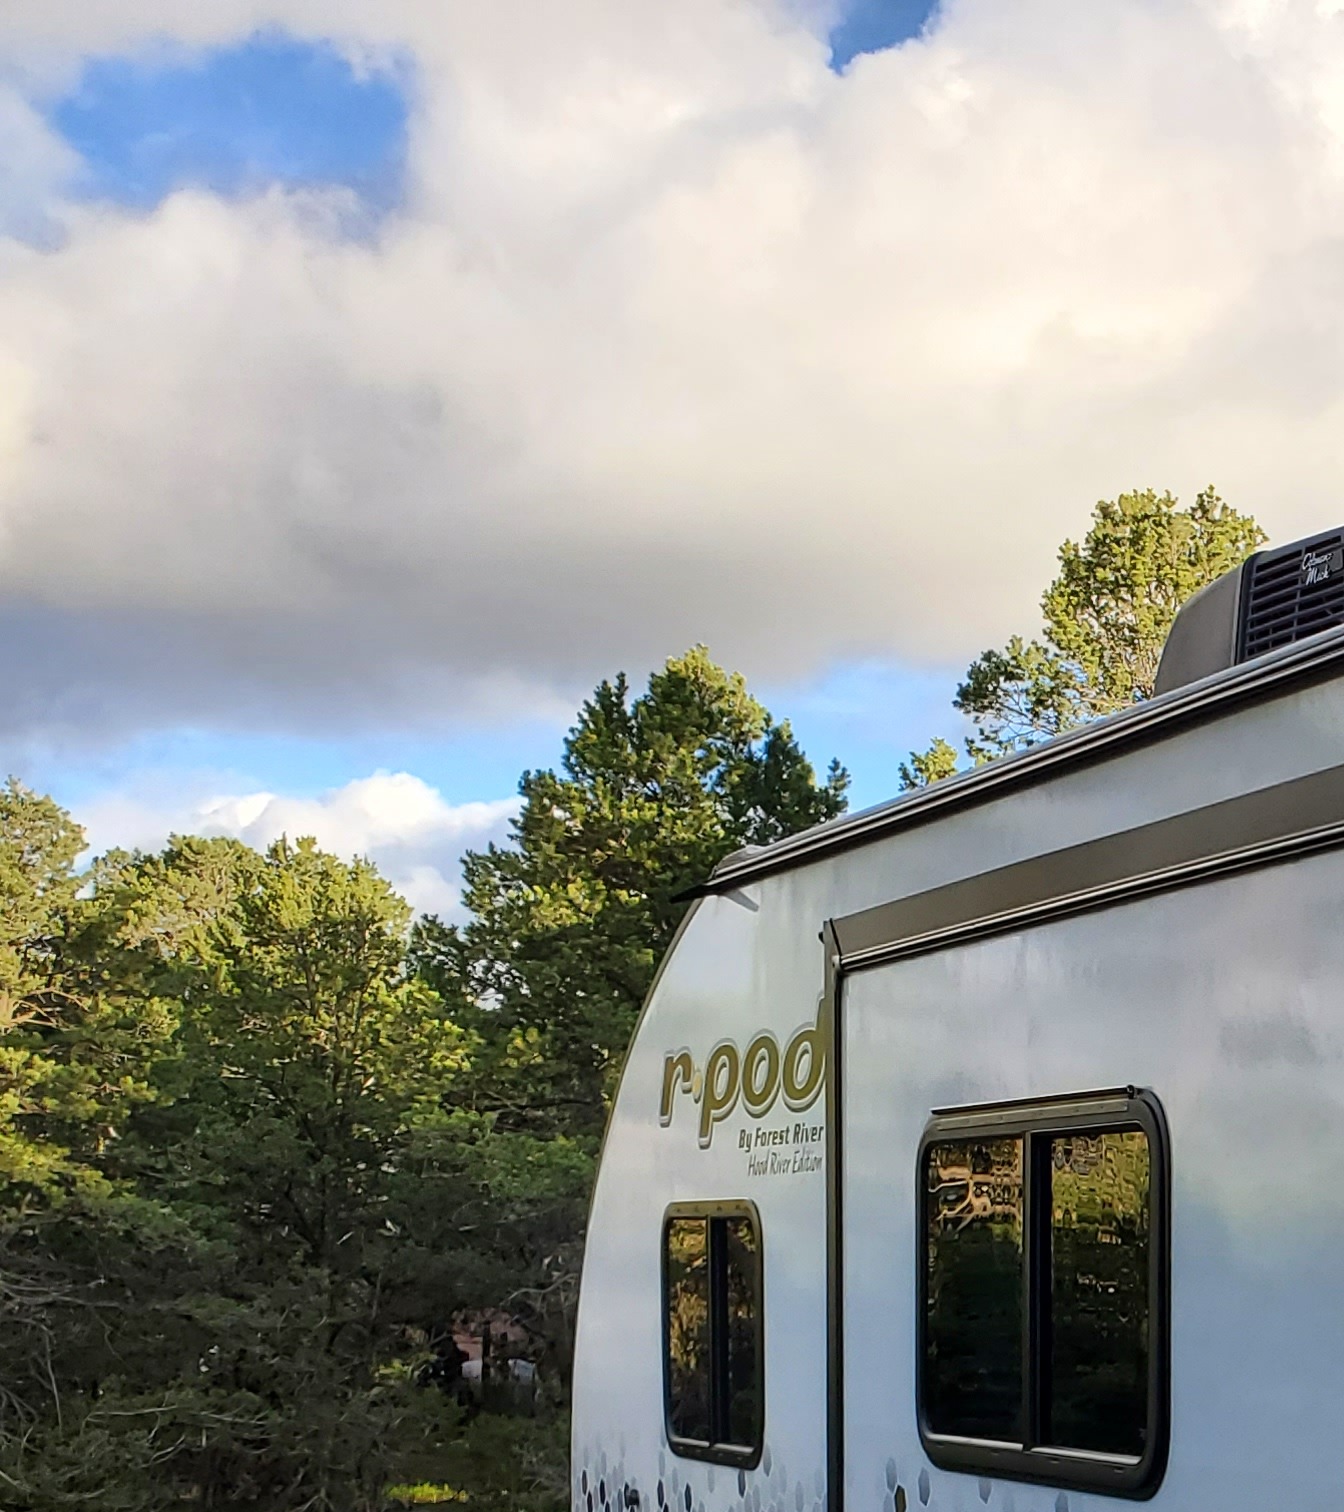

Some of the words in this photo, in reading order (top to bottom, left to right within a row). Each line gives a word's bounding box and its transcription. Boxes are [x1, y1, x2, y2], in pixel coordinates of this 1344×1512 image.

[738, 1128, 753, 1152] By
[755, 1124, 790, 1147] Forest
[793, 1122, 824, 1145] River
[748, 1149, 768, 1176] Hood
[769, 1151, 791, 1175] River
[792, 1146, 823, 1173] Edition
